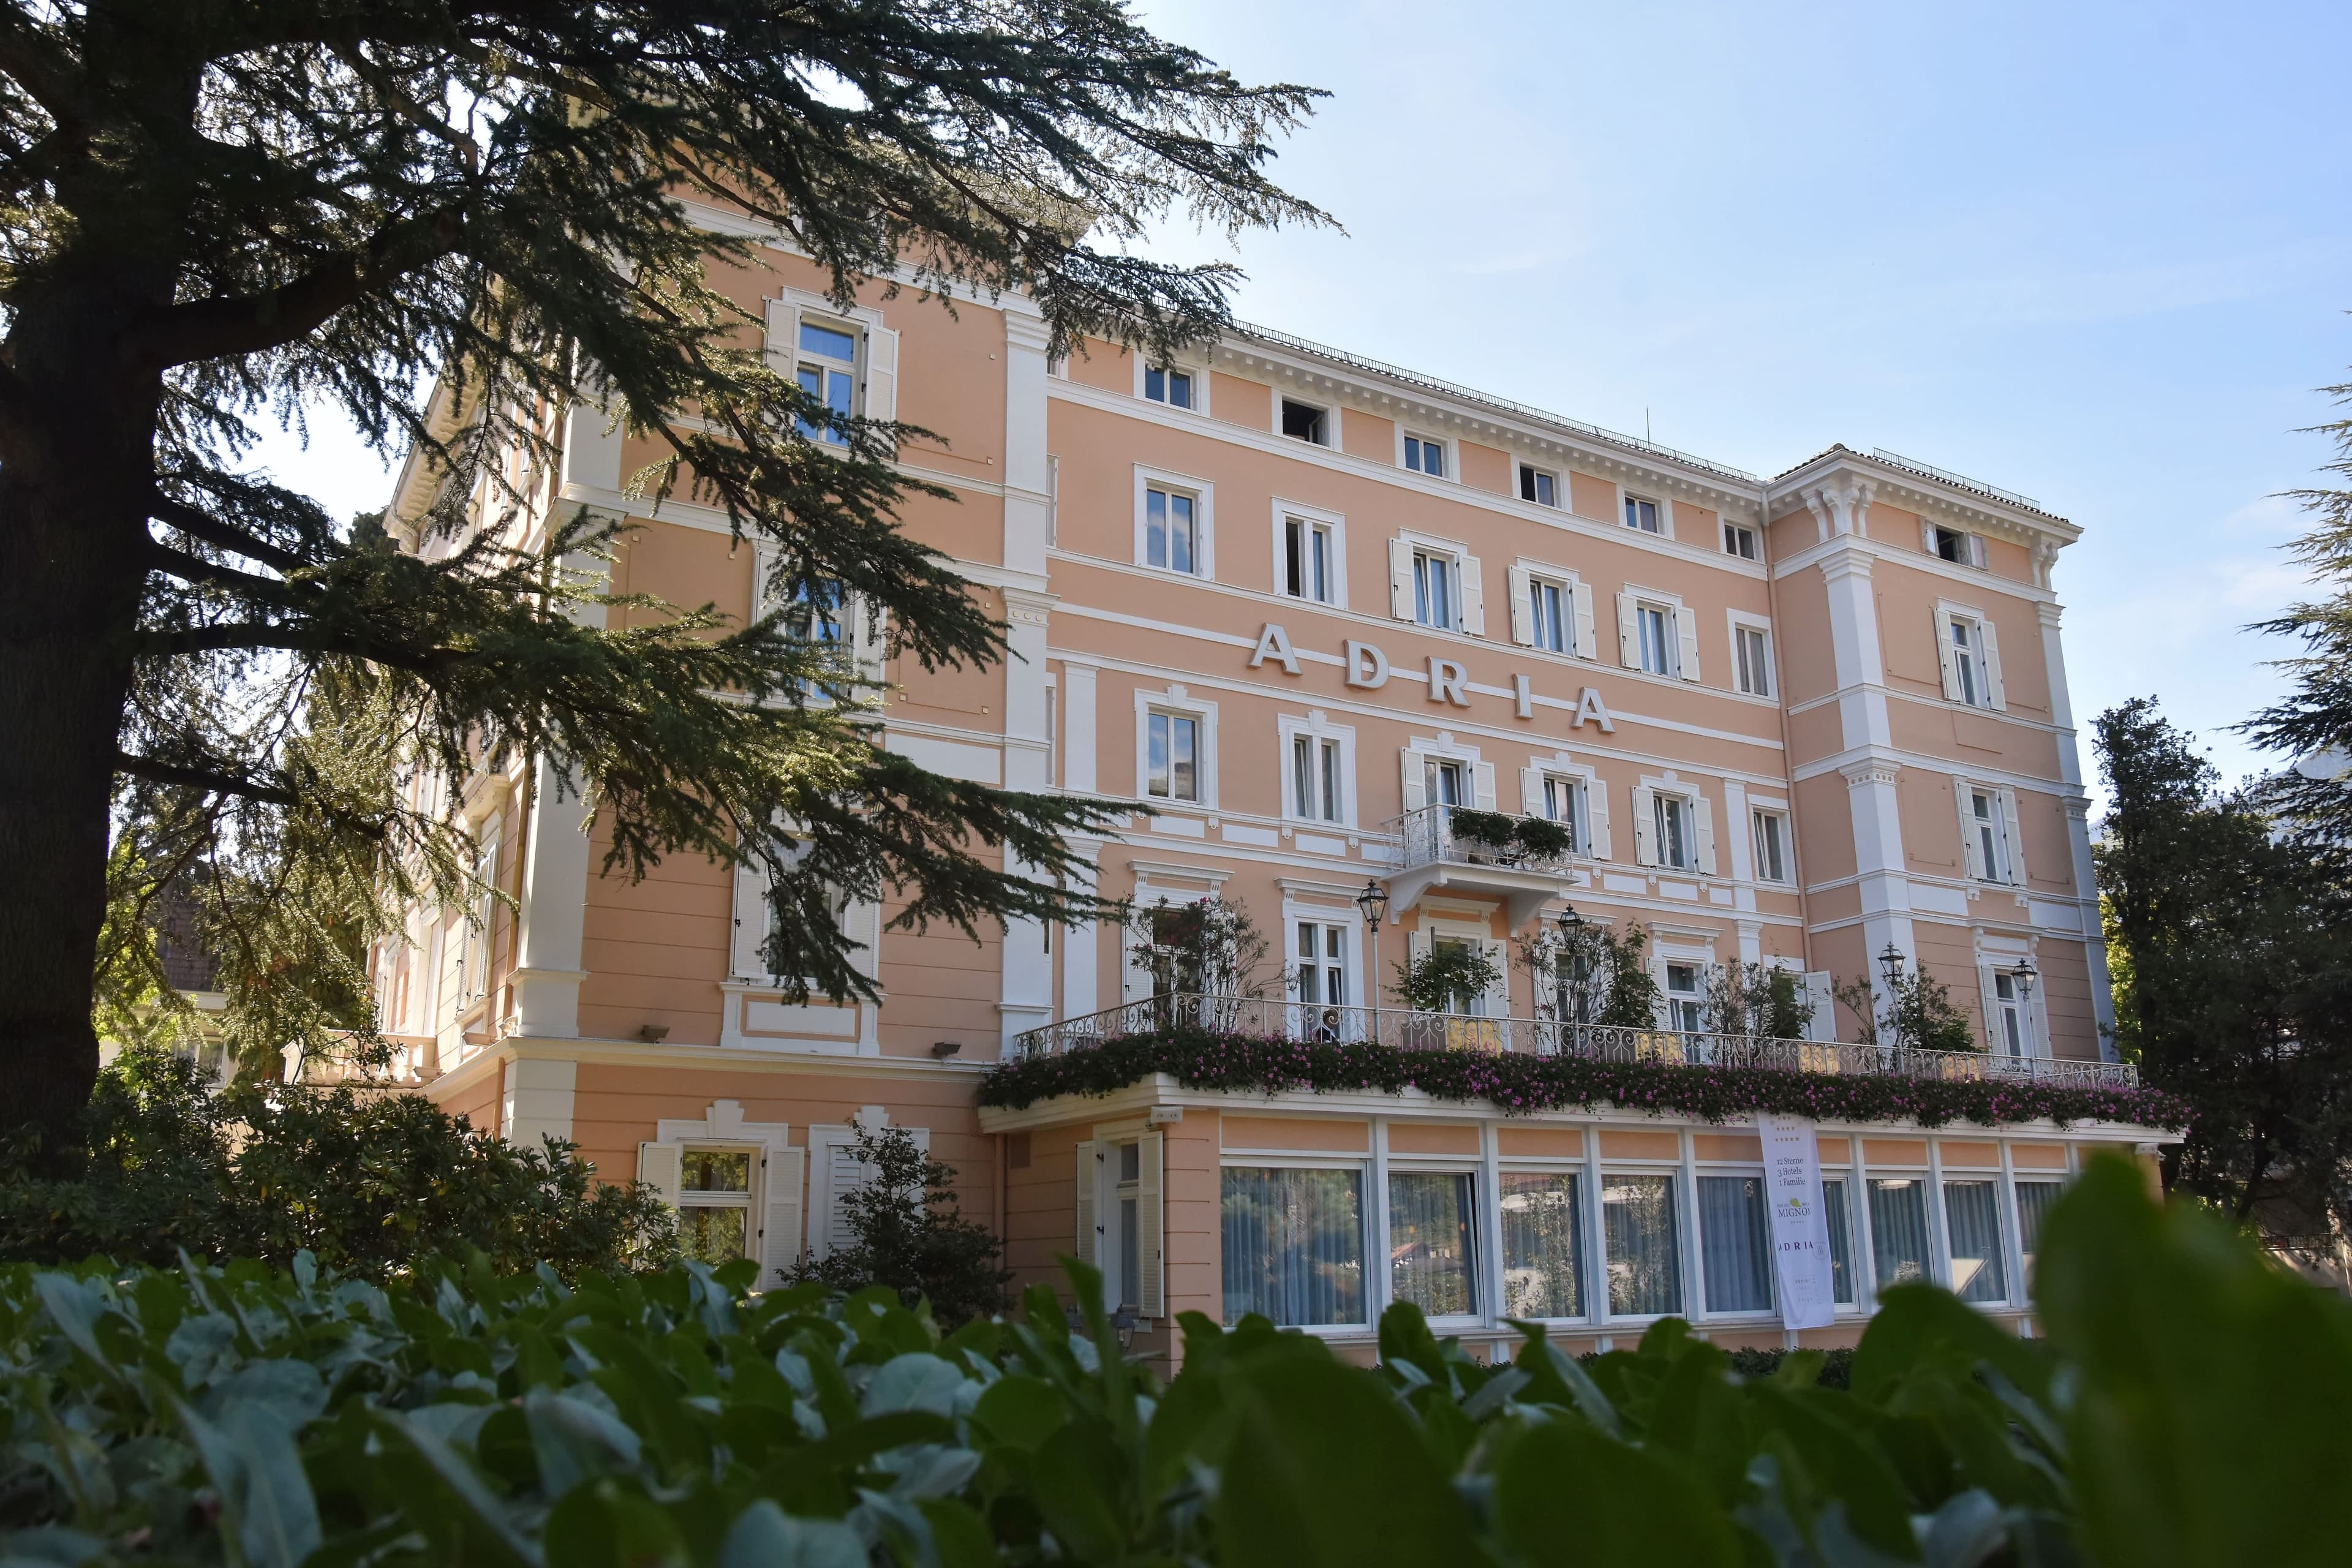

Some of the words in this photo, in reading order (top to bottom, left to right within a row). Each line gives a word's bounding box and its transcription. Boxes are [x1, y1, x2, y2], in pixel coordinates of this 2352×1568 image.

[1246, 622, 1616, 734] ADRIA
[1782, 1166, 1803, 1175] Hotels
[1783, 1177, 1806, 1186] Familie
[1778, 1241, 1814, 1251] ADRIA
